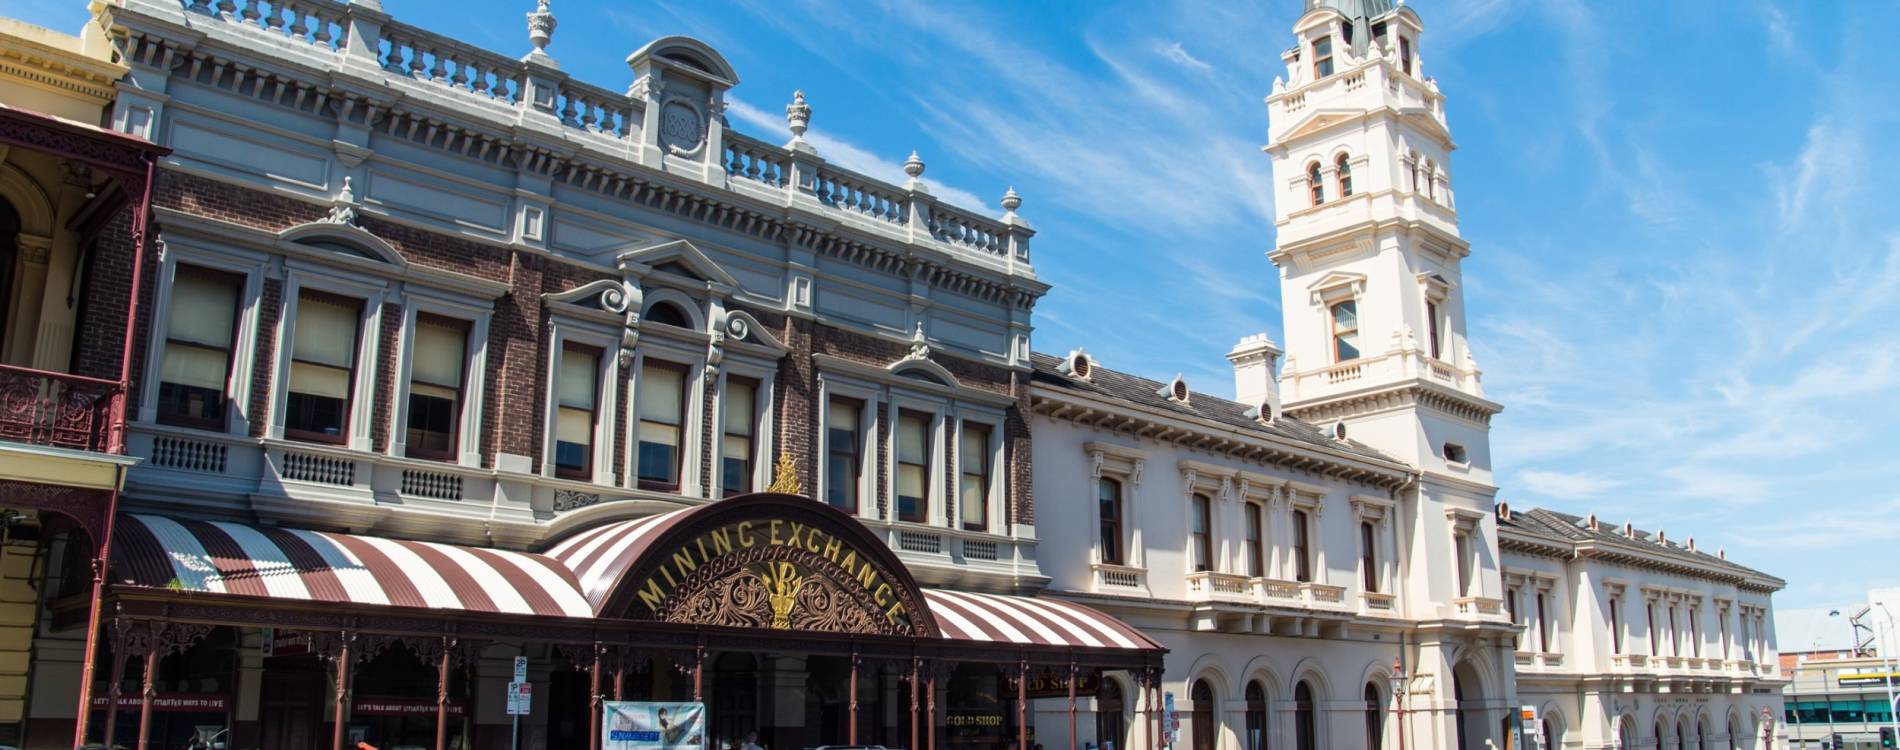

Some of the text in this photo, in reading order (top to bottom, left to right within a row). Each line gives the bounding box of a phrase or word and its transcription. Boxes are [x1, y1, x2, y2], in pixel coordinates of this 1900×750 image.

[665, 112, 697, 142] 1888
[637, 519, 907, 626] MINING EXCHANGE
[208, 700, 224, 708] LIVE
[946, 715, 1003, 726] GOLD SHOP
